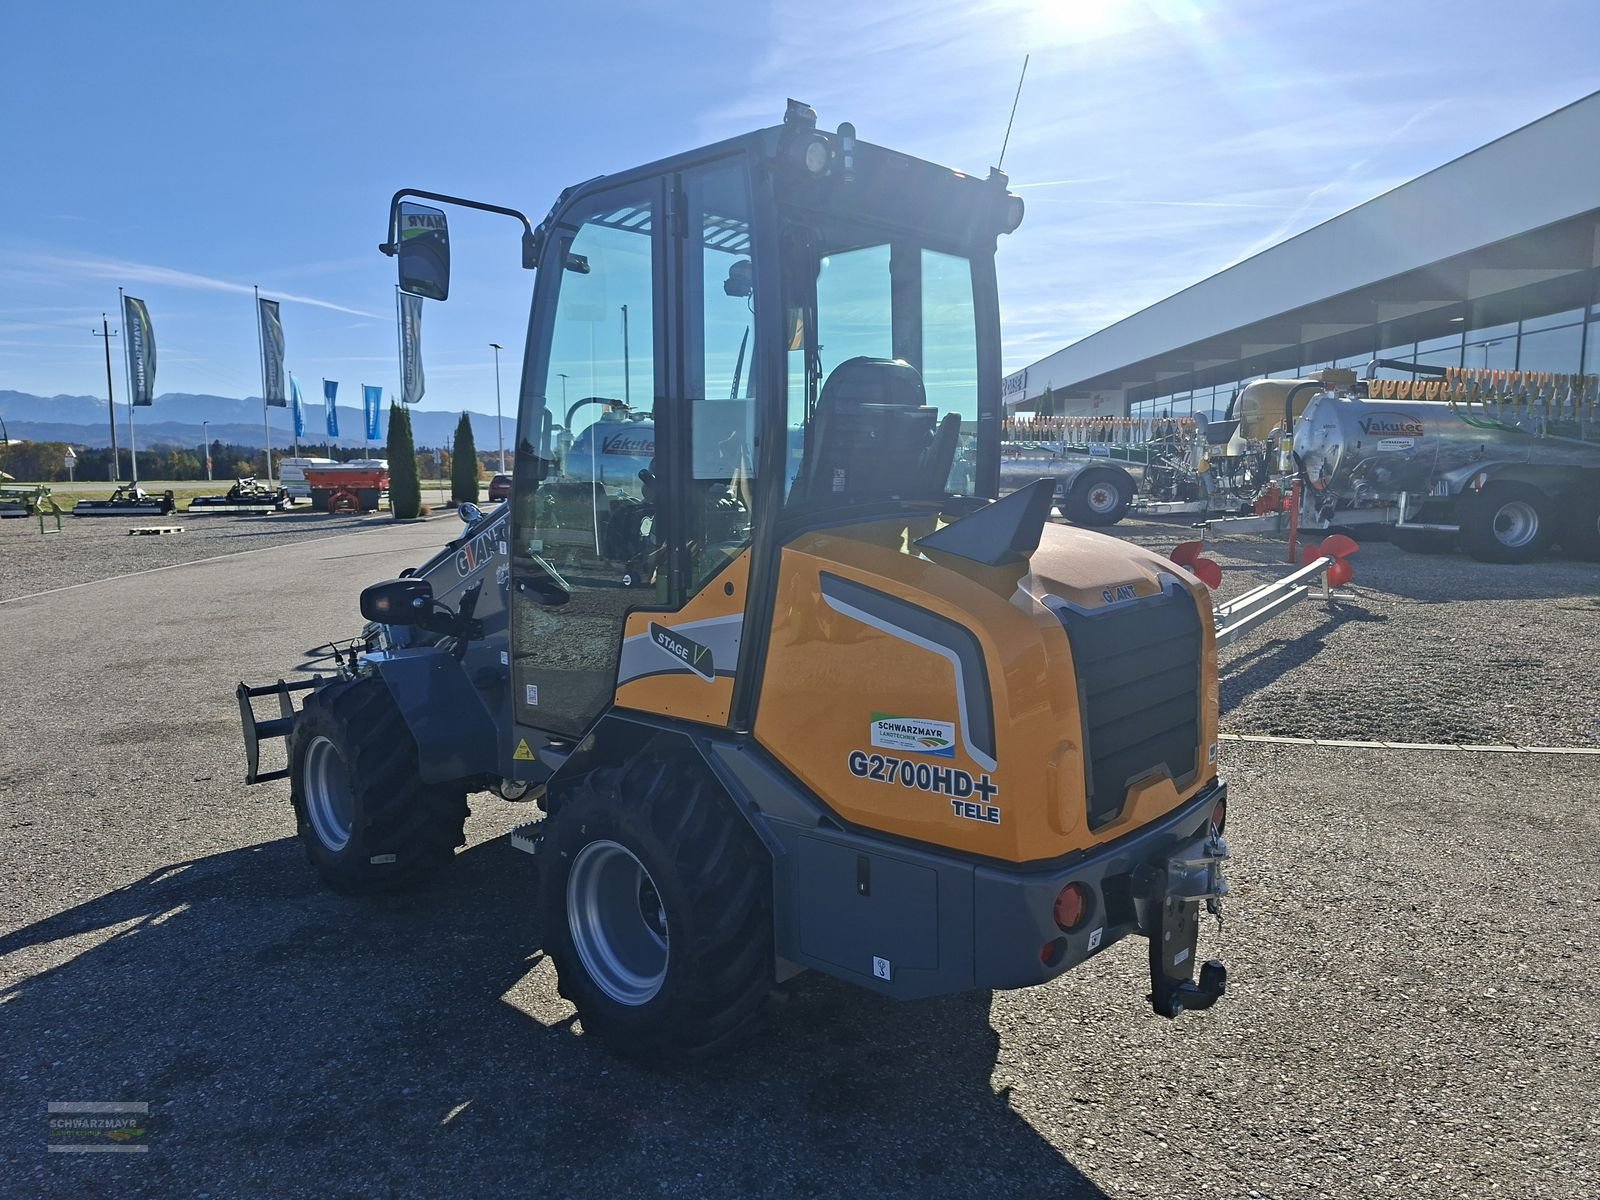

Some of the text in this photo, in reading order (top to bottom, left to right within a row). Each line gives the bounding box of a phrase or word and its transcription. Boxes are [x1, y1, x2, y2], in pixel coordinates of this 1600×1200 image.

[133, 318, 145, 392] SCHWARZMAYR
[1358, 418, 1424, 434] Vakutec
[1103, 584, 1137, 604] GIANT
[658, 632, 710, 665] STAGE V
[878, 721, 943, 738] SCHWARZMAYR
[879, 730, 917, 742] LANDTECHNIK
[848, 750, 999, 802] G2700HD+
[951, 799, 1001, 825] TELE
